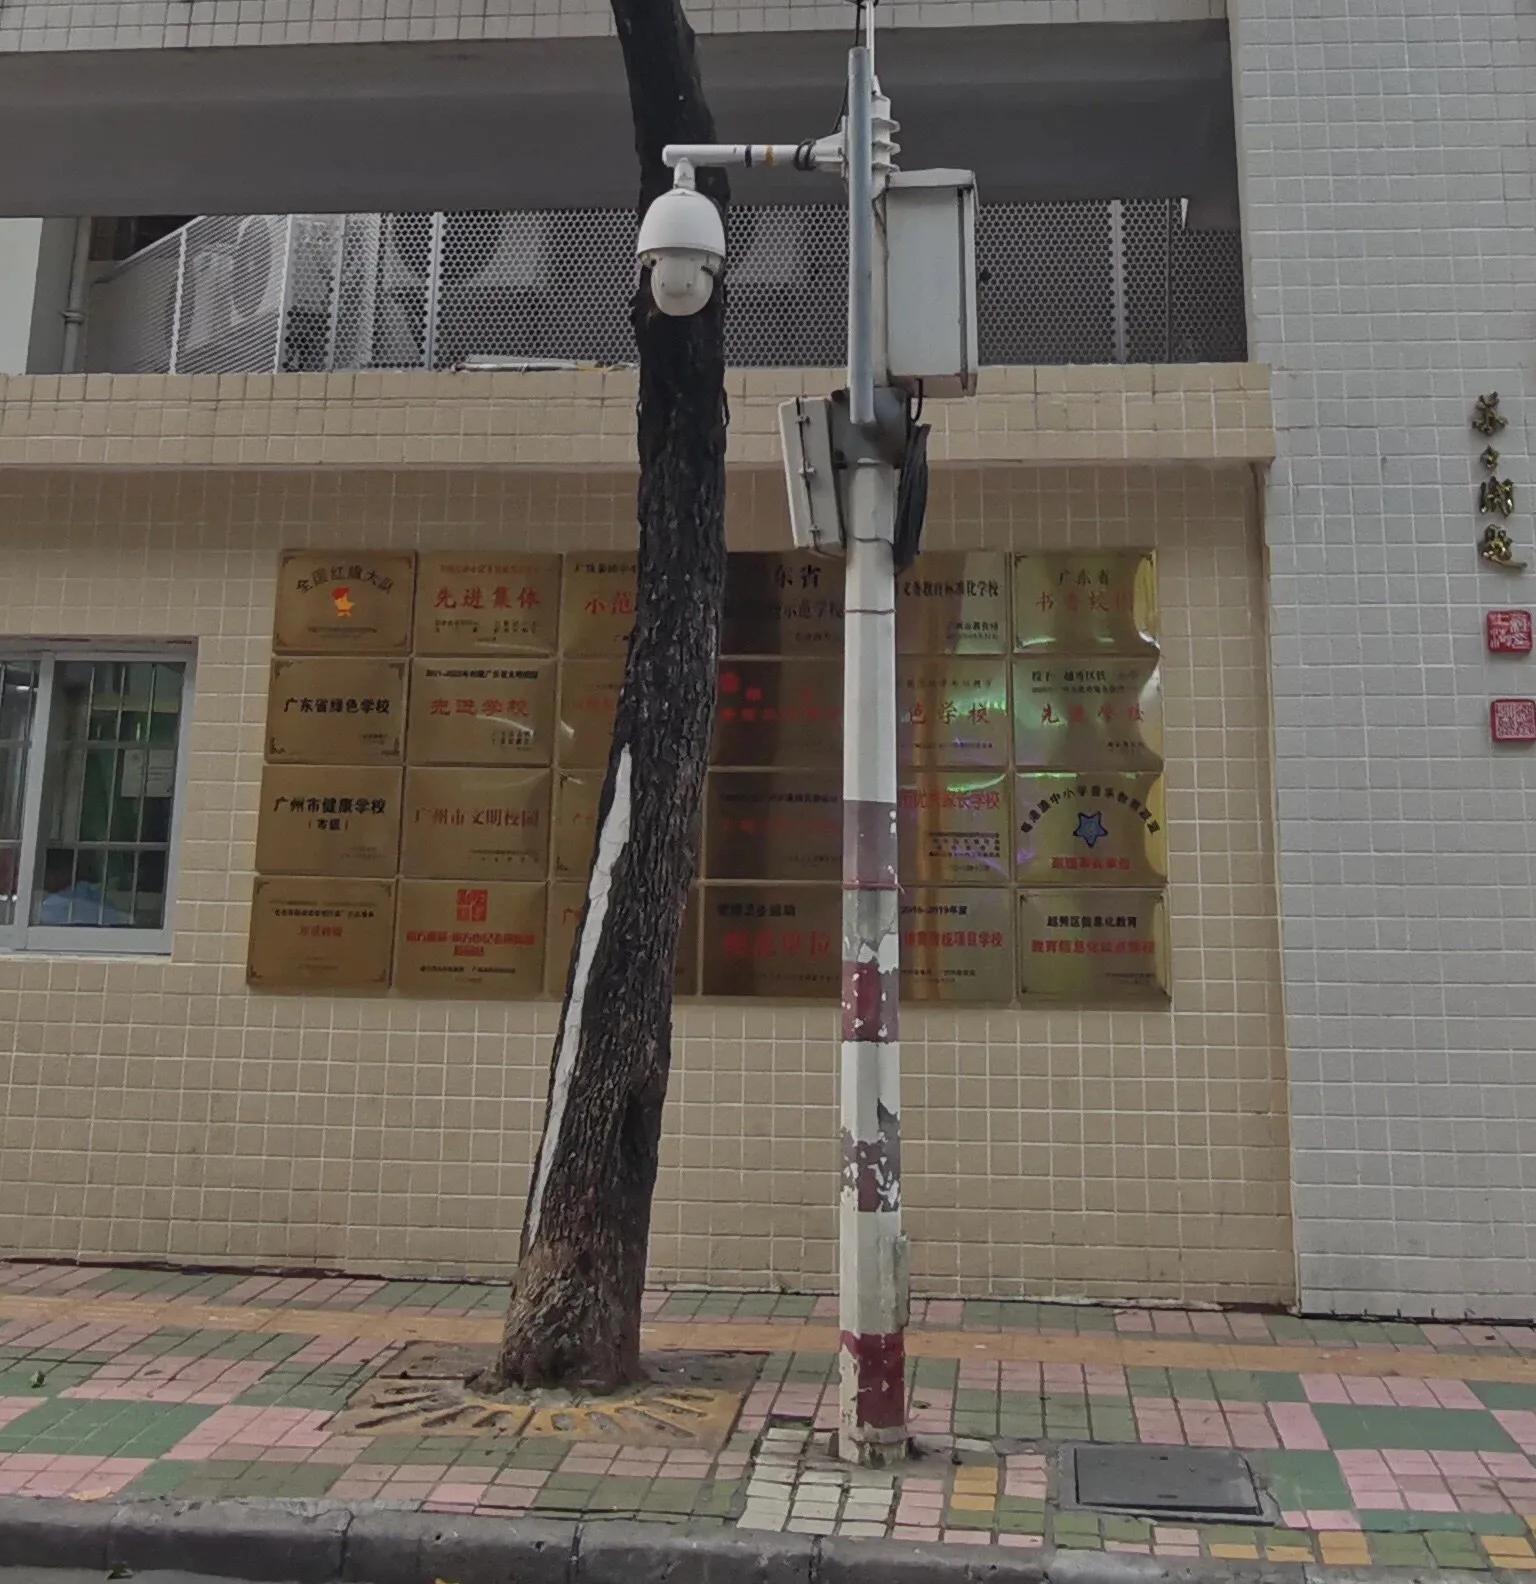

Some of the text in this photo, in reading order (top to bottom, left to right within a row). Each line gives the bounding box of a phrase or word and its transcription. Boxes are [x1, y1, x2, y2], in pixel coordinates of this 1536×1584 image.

[433, 584, 541, 609] 先进集体
[283, 697, 391, 714] 广东省绿色学校
[273, 797, 387, 814] 广州市健康学校
[413, 807, 540, 828] 广州市文明校园
